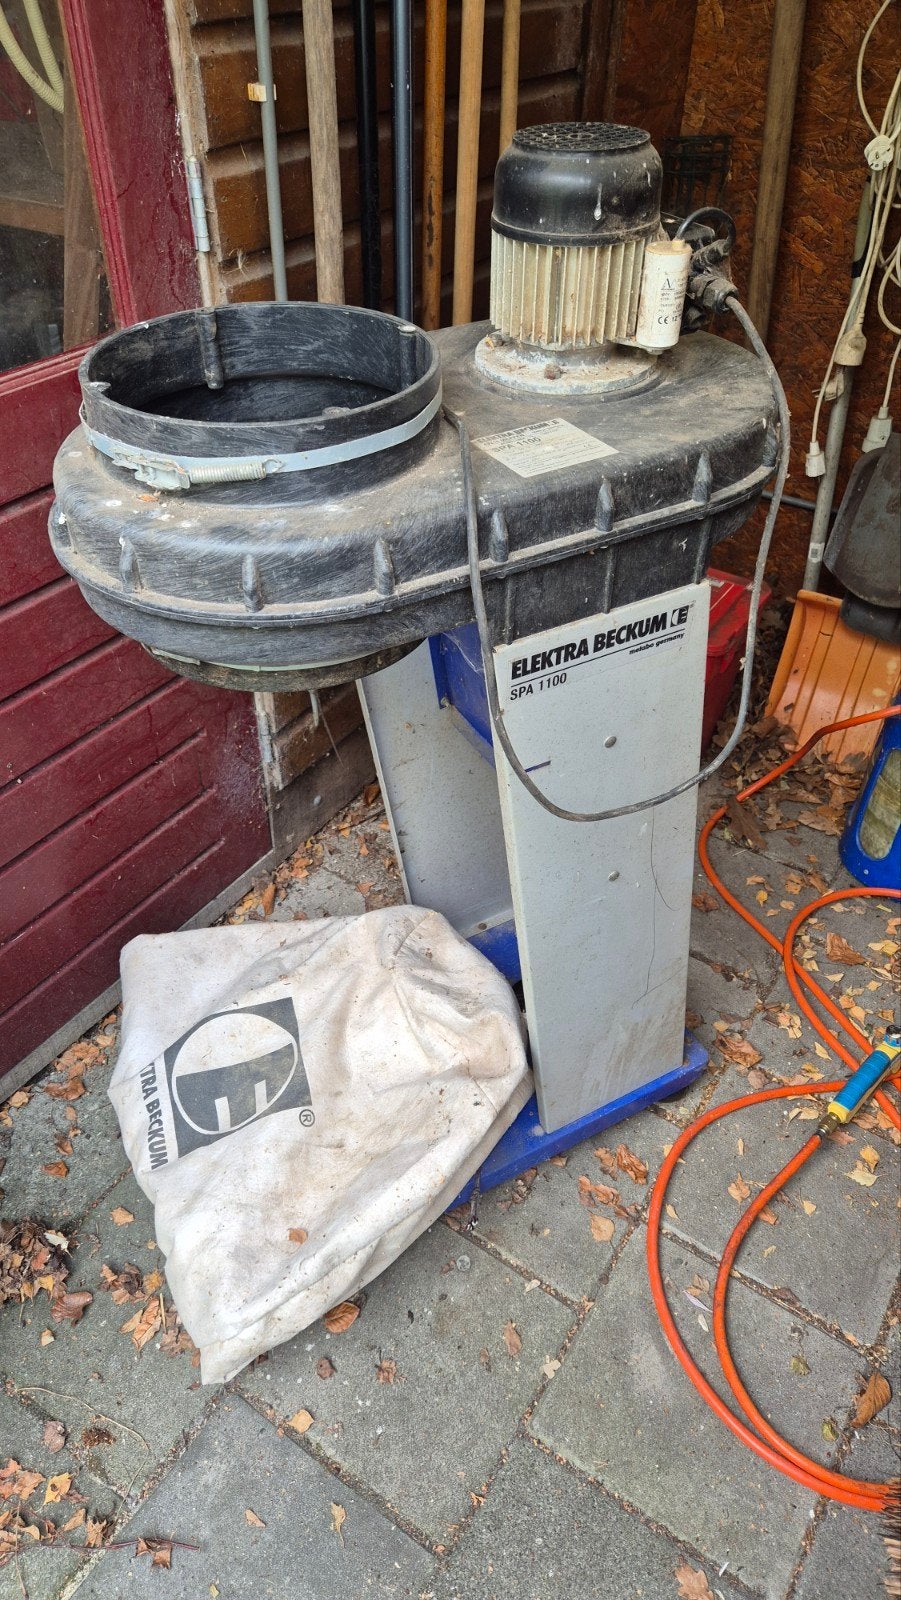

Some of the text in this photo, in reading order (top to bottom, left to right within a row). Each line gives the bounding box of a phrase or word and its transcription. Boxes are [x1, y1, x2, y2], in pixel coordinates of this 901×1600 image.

[516, 436, 541, 446] 1100
[511, 637, 589, 680] ELEKTRA
[593, 612, 667, 653] BECKUM
[629, 632, 685, 655] metabo germany
[510, 672, 567, 701] SPA 1100
[145, 1098, 168, 1170] BECKUM
